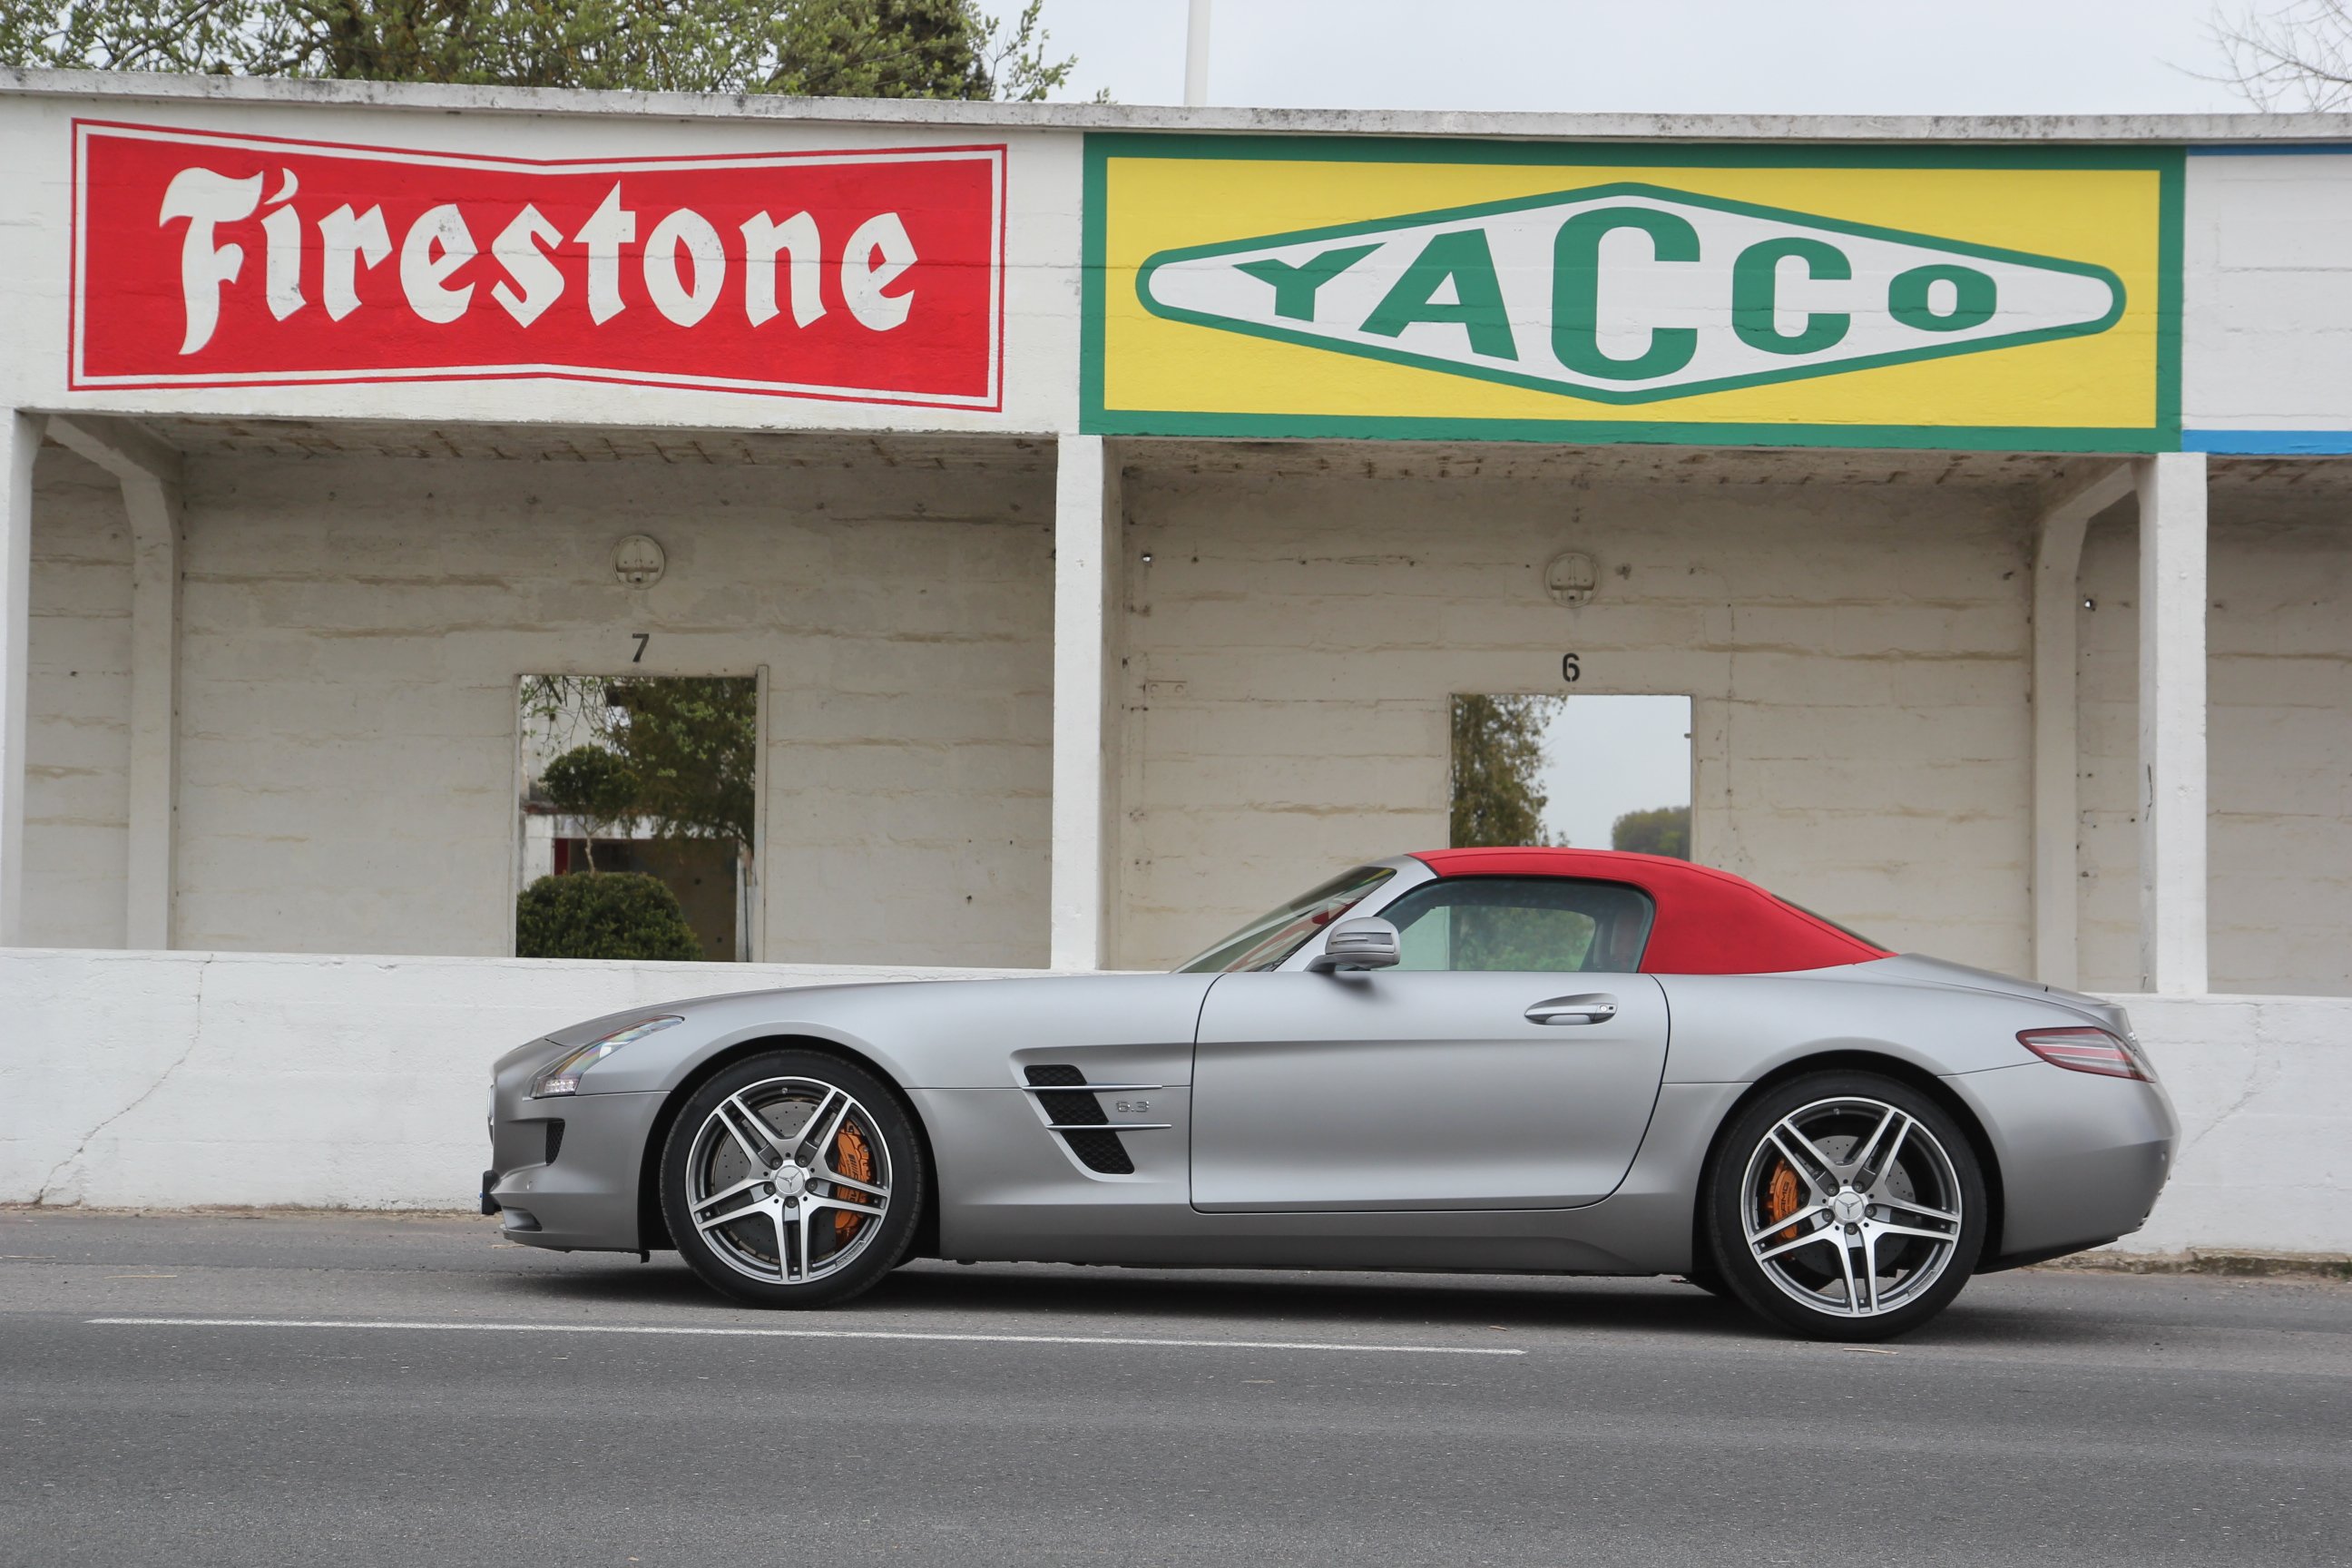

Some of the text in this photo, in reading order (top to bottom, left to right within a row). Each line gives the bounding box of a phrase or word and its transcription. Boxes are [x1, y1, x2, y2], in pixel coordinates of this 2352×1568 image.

[158, 166, 919, 356] Firestone
[632, 633, 650, 662] 7
[1562, 652, 1580, 682] 6
[1115, 1100, 1150, 1113] 6.3
